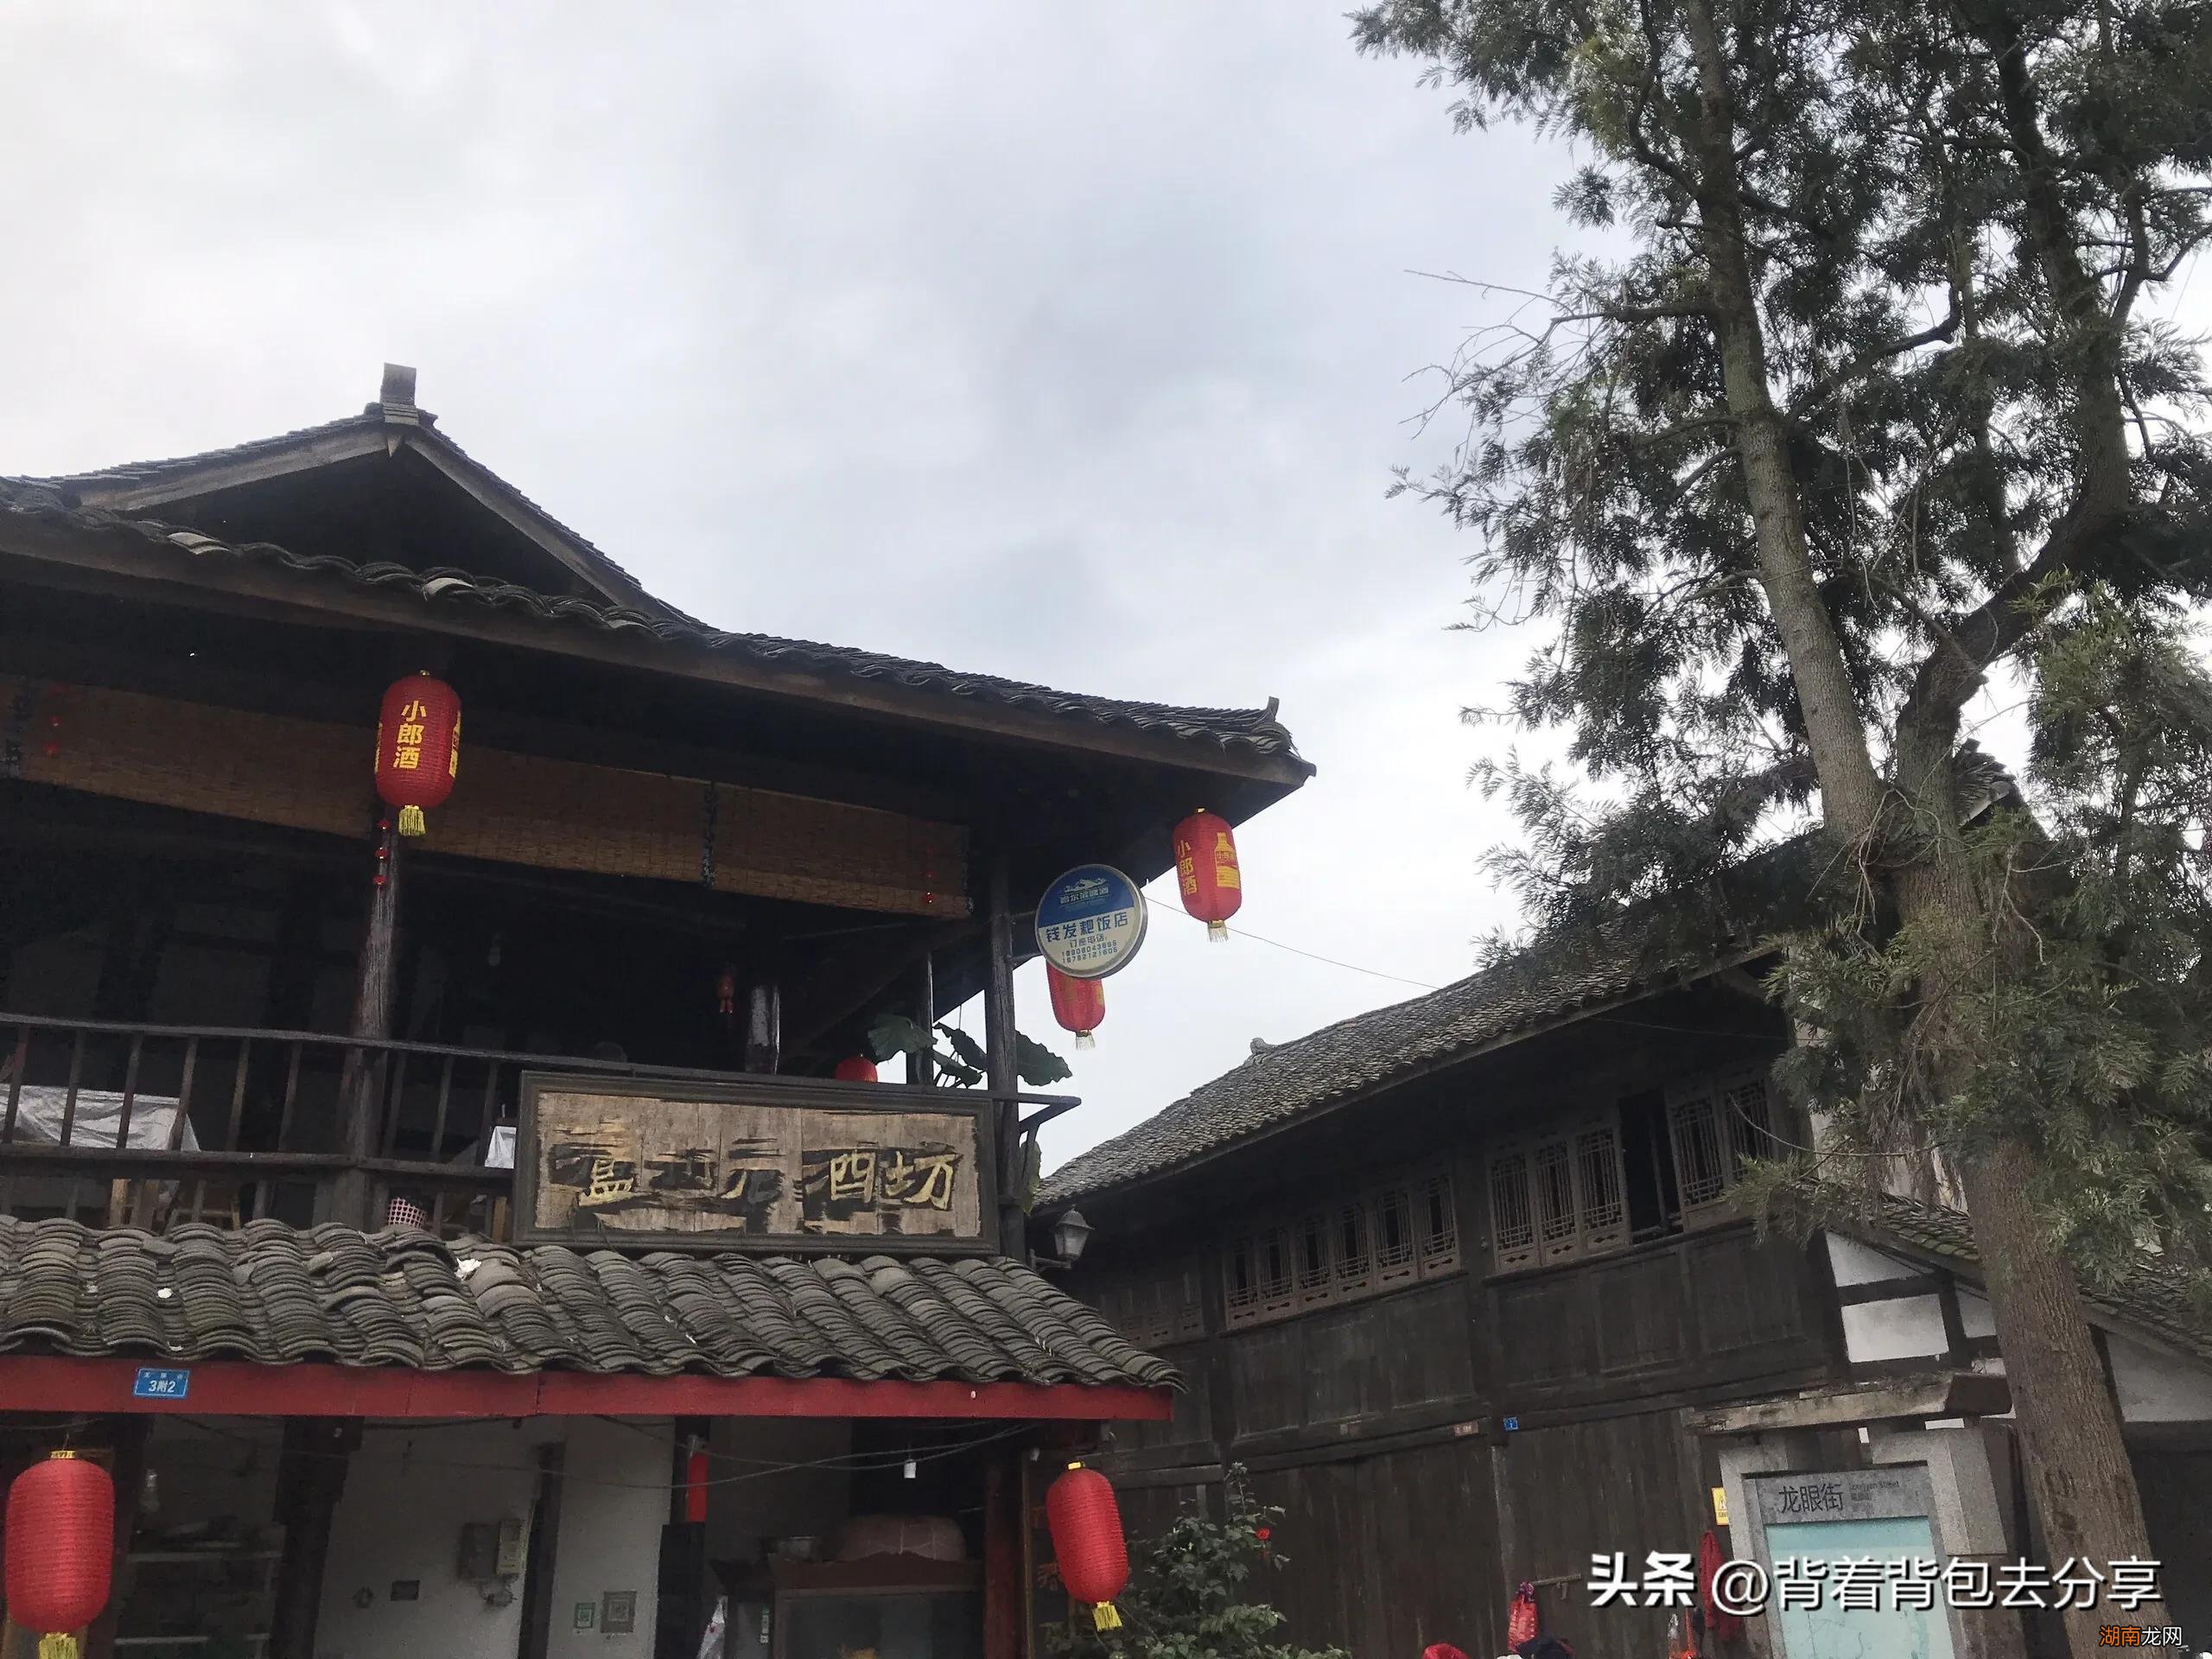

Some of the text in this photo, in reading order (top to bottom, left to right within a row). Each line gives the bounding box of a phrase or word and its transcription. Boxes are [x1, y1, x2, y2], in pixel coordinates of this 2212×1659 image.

[393, 700, 428, 769] 小郎酒
[1178, 839, 1198, 896] 小郎酒
[1779, 1483, 1844, 1514] 龙眼街
